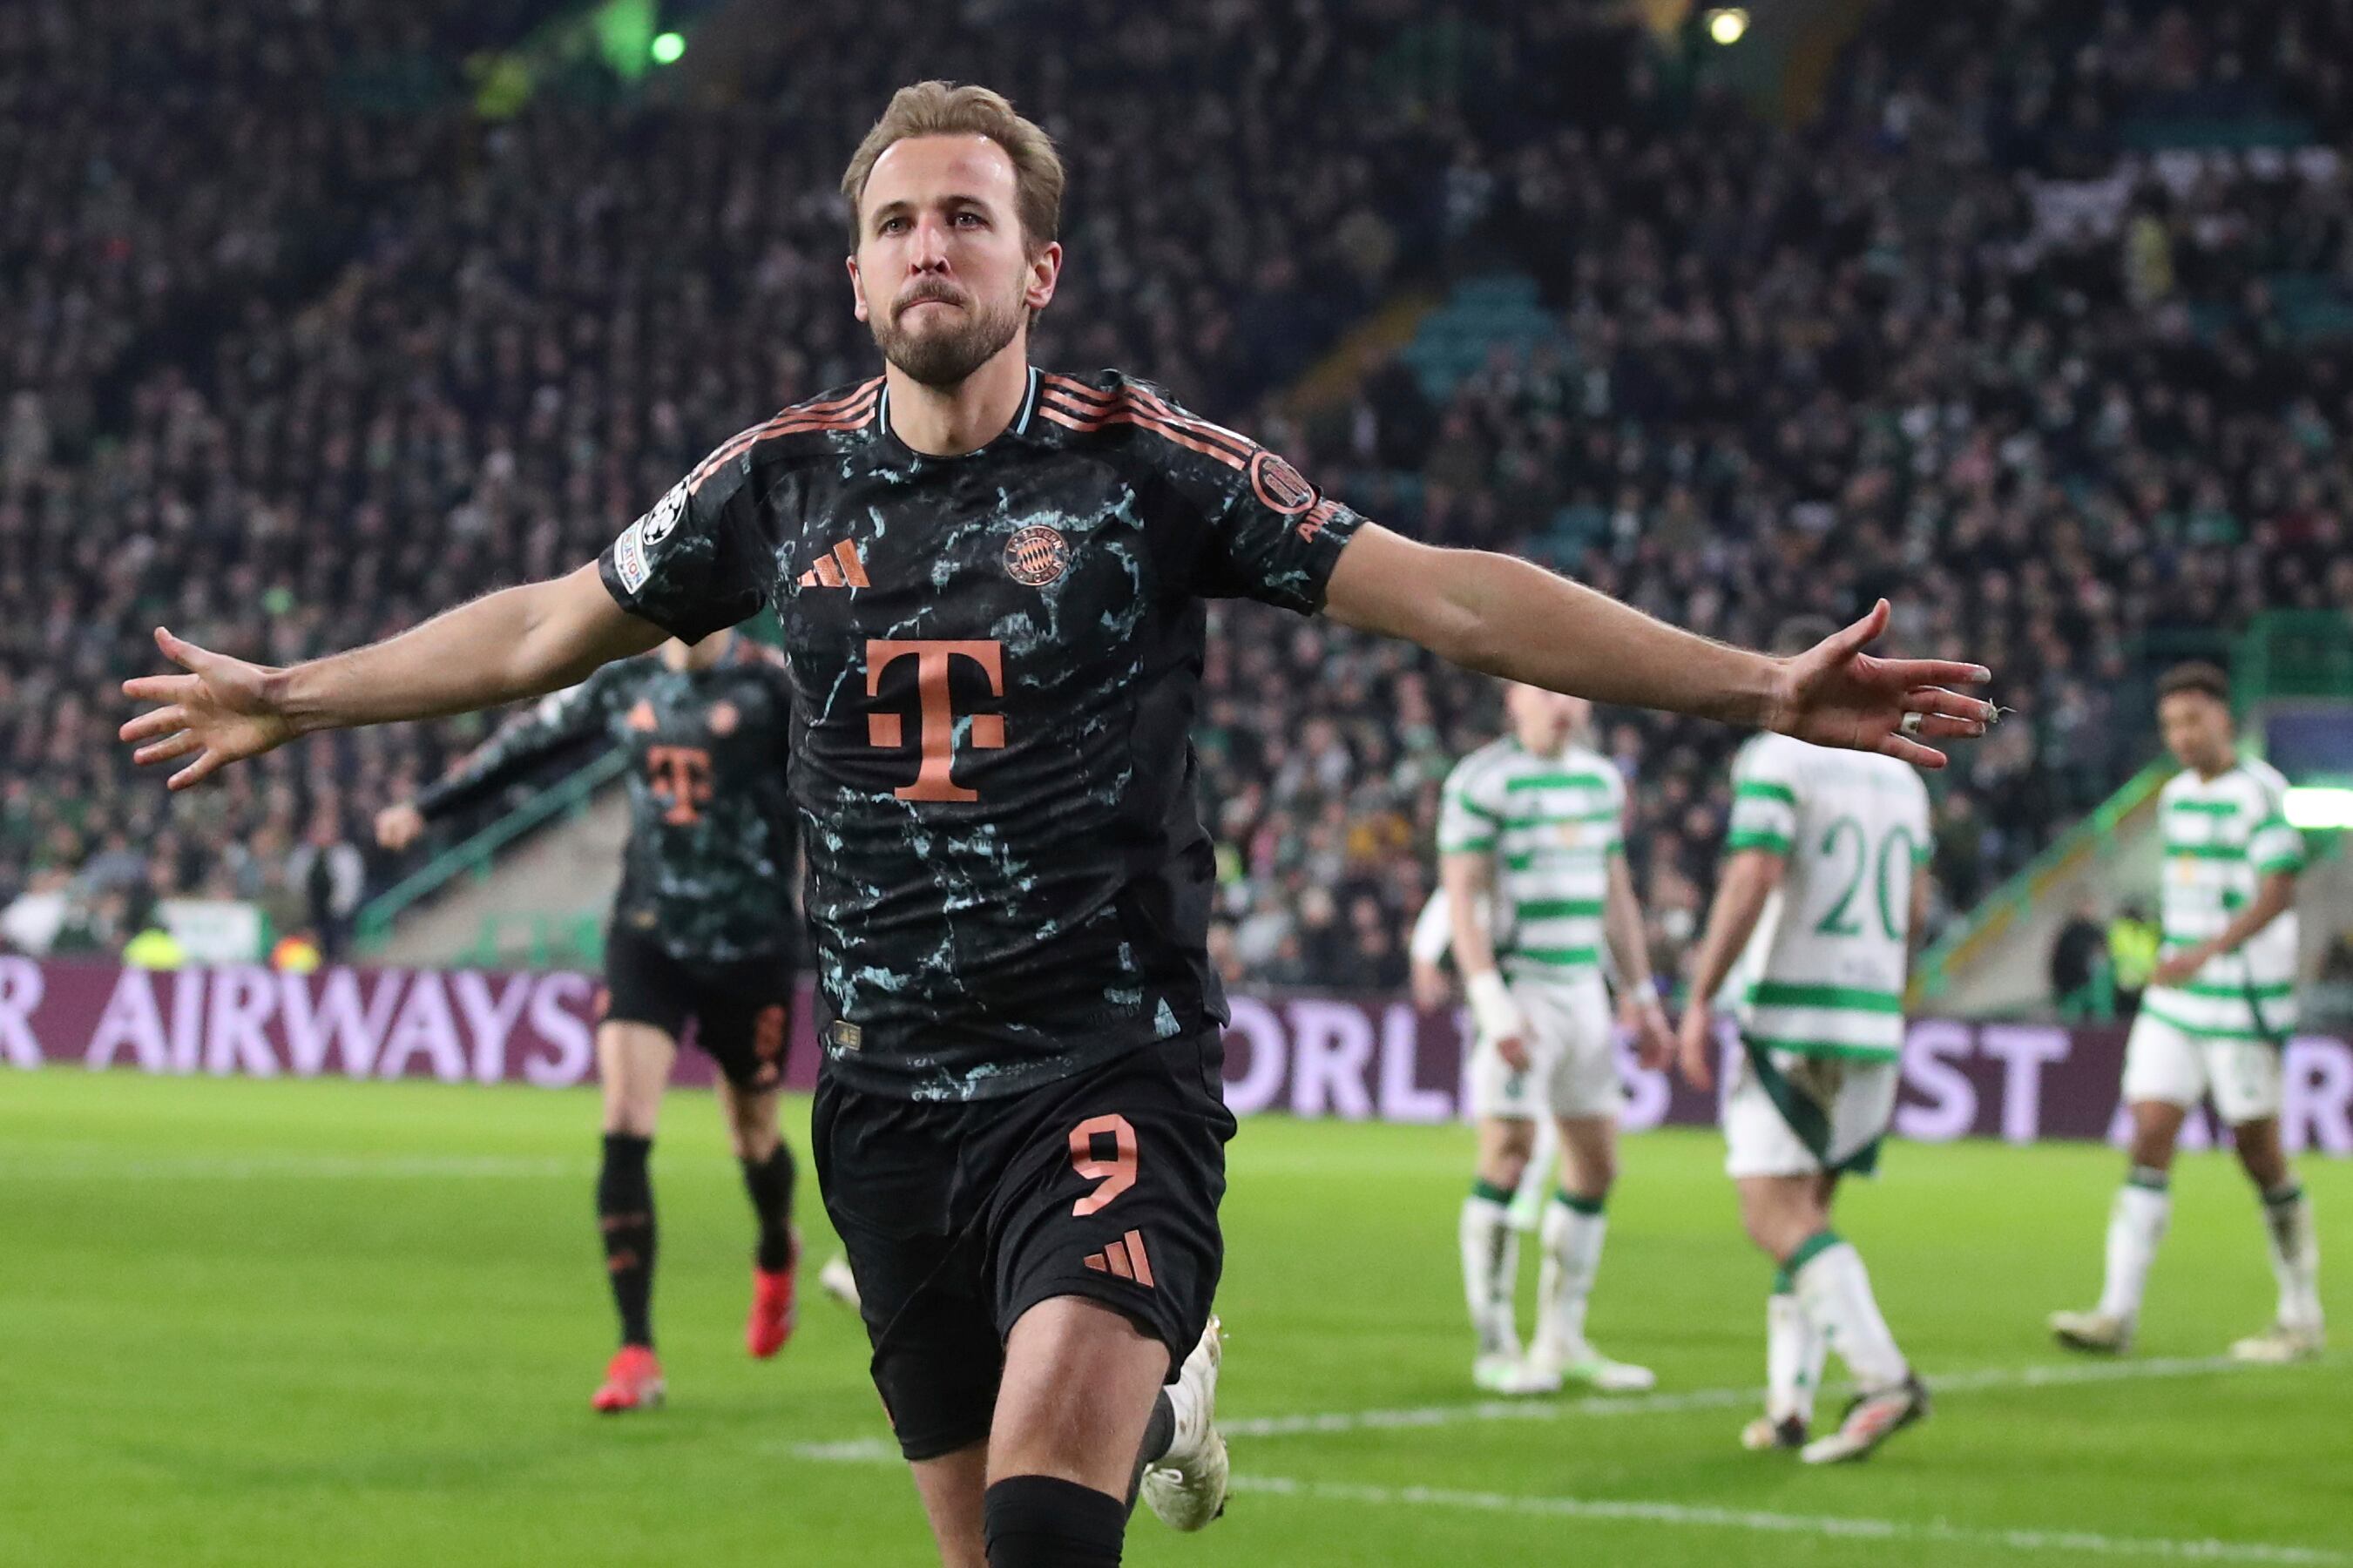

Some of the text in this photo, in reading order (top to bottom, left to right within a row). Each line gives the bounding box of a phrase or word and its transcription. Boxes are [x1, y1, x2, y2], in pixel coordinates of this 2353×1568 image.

[866, 639, 1005, 802] T
[646, 745, 713, 824] T
[1815, 814, 1914, 942] 20
[85, 963, 598, 1087] AIRWAYS
[1068, 1112, 1138, 1217] 9
